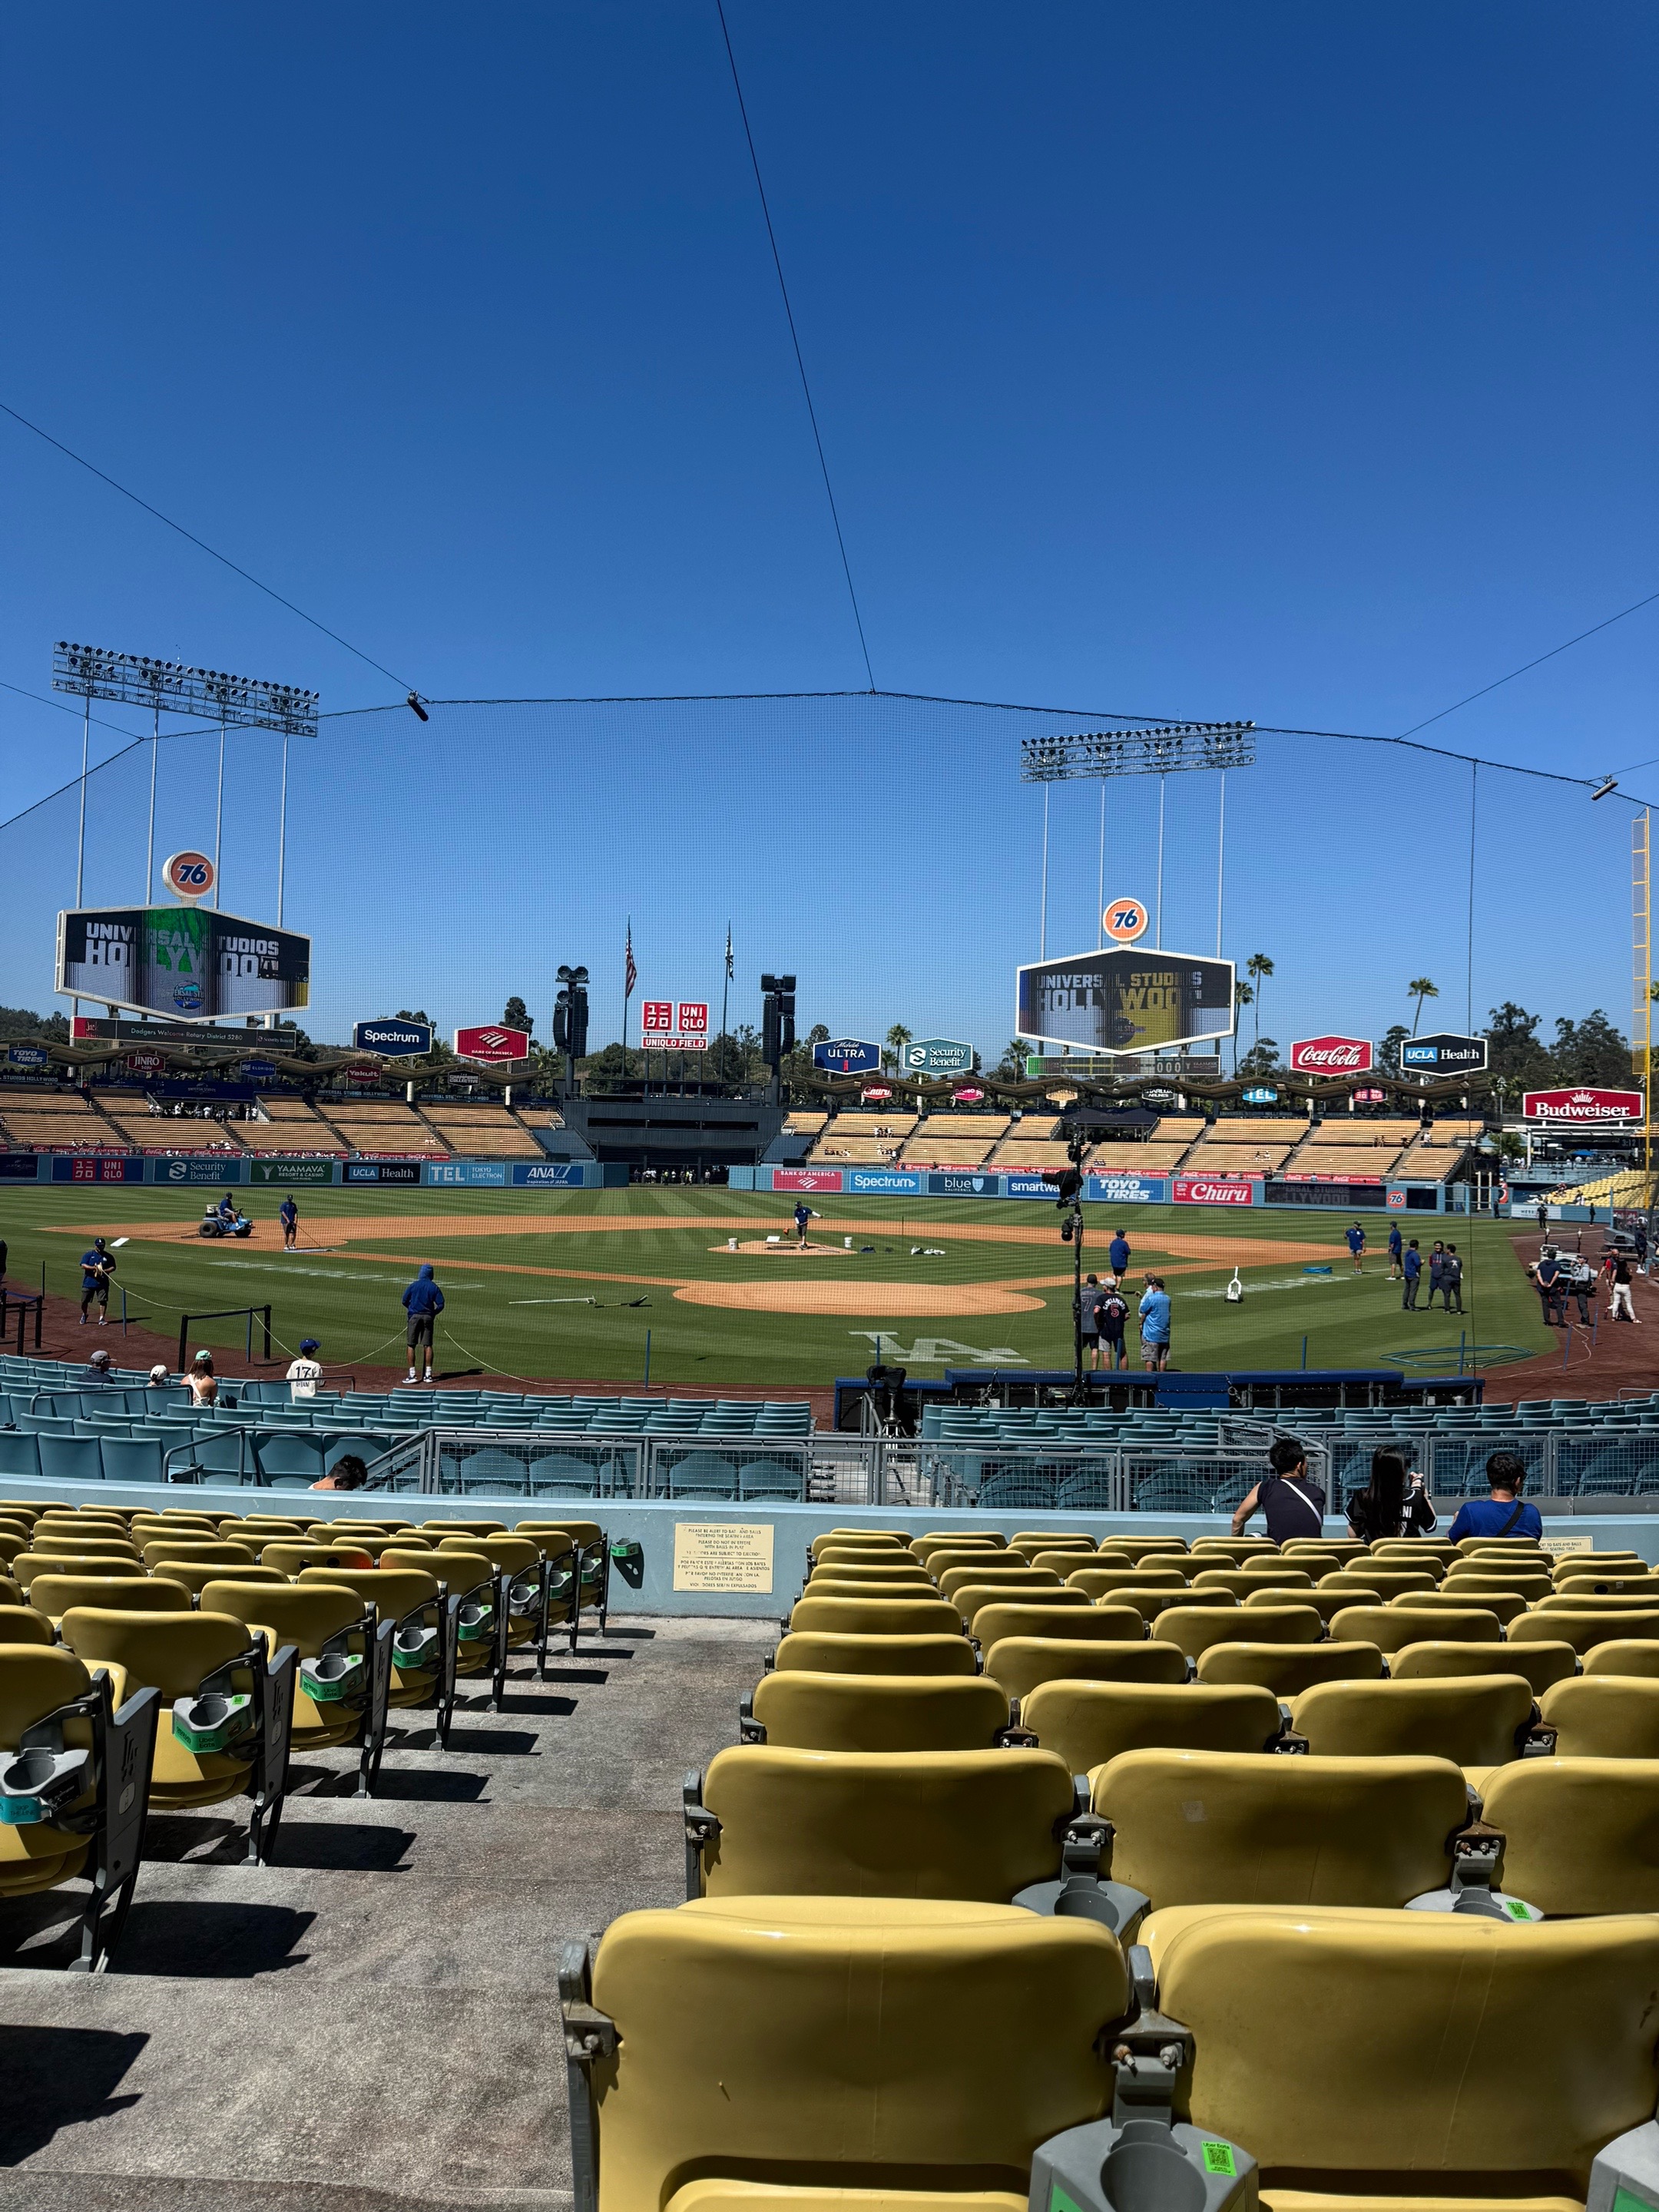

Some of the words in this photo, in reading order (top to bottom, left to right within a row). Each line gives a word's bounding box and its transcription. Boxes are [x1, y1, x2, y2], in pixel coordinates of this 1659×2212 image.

[177, 863, 207, 885] 76
[1112, 909, 1139, 929] 76
[647, 1005, 669, 1015] ユニ
[682, 1006, 703, 1018] UNI
[647, 1017, 669, 1028] クロ
[682, 1018, 704, 1029] QLO
[131, 1028, 156, 1036] Dodgers
[157, 1029, 184, 1038] Welcome
[186, 1031, 205, 1040] Rotary
[364, 1029, 419, 1044] Spectrum
[645, 1038, 677, 1048] UNIQLO
[679, 1039, 704, 1048] FIELD
[827, 1048, 866, 1059] ULTRA
[929, 1047, 966, 1058] Security
[1297, 1045, 1364, 1066] Coca-Cola
[1407, 1050, 1435, 1060] UCLA
[1440, 1048, 1480, 1060] Health
[134, 1056, 160, 1067] JINRO
[929, 1057, 961, 1067] Benefit
[1157, 1061, 1163, 1073] 0
[1166, 1061, 1172, 1073] 0
[1174, 1061, 1181, 1073] 0
[1246, 1088, 1273, 1100] TEL
[1535, 1102, 1630, 1117] Budweiser
[76, 1161, 94, 1169] ユニ
[190, 1161, 227, 1173] Security
[75, 1170, 93, 1178] クロ
[104, 1170, 122, 1178] QLO
[190, 1171, 221, 1181] Benefit
[353, 1168, 376, 1177] UCLA
[382, 1168, 414, 1178] Health
[431, 1166, 465, 1181] TEL
[527, 1167, 555, 1178] ANA
[854, 1174, 912, 1188] Spectrum
[945, 1177, 971, 1188] blue
[1011, 1181, 1060, 1192] smartwa
[1100, 1179, 1141, 1190] TOYO
[1106, 1190, 1150, 1200] TIRES
[1190, 1183, 1248, 1202] Churu
[1313, 1185, 1350, 1194] STUDIOS
[1389, 1193, 1402, 1204] 76
[1081, 1296, 1094, 1312] 7
[1109, 1303, 1120, 1318] 5
[848, 1331, 1031, 1363] LA
[296, 1366, 312, 1379] 17
